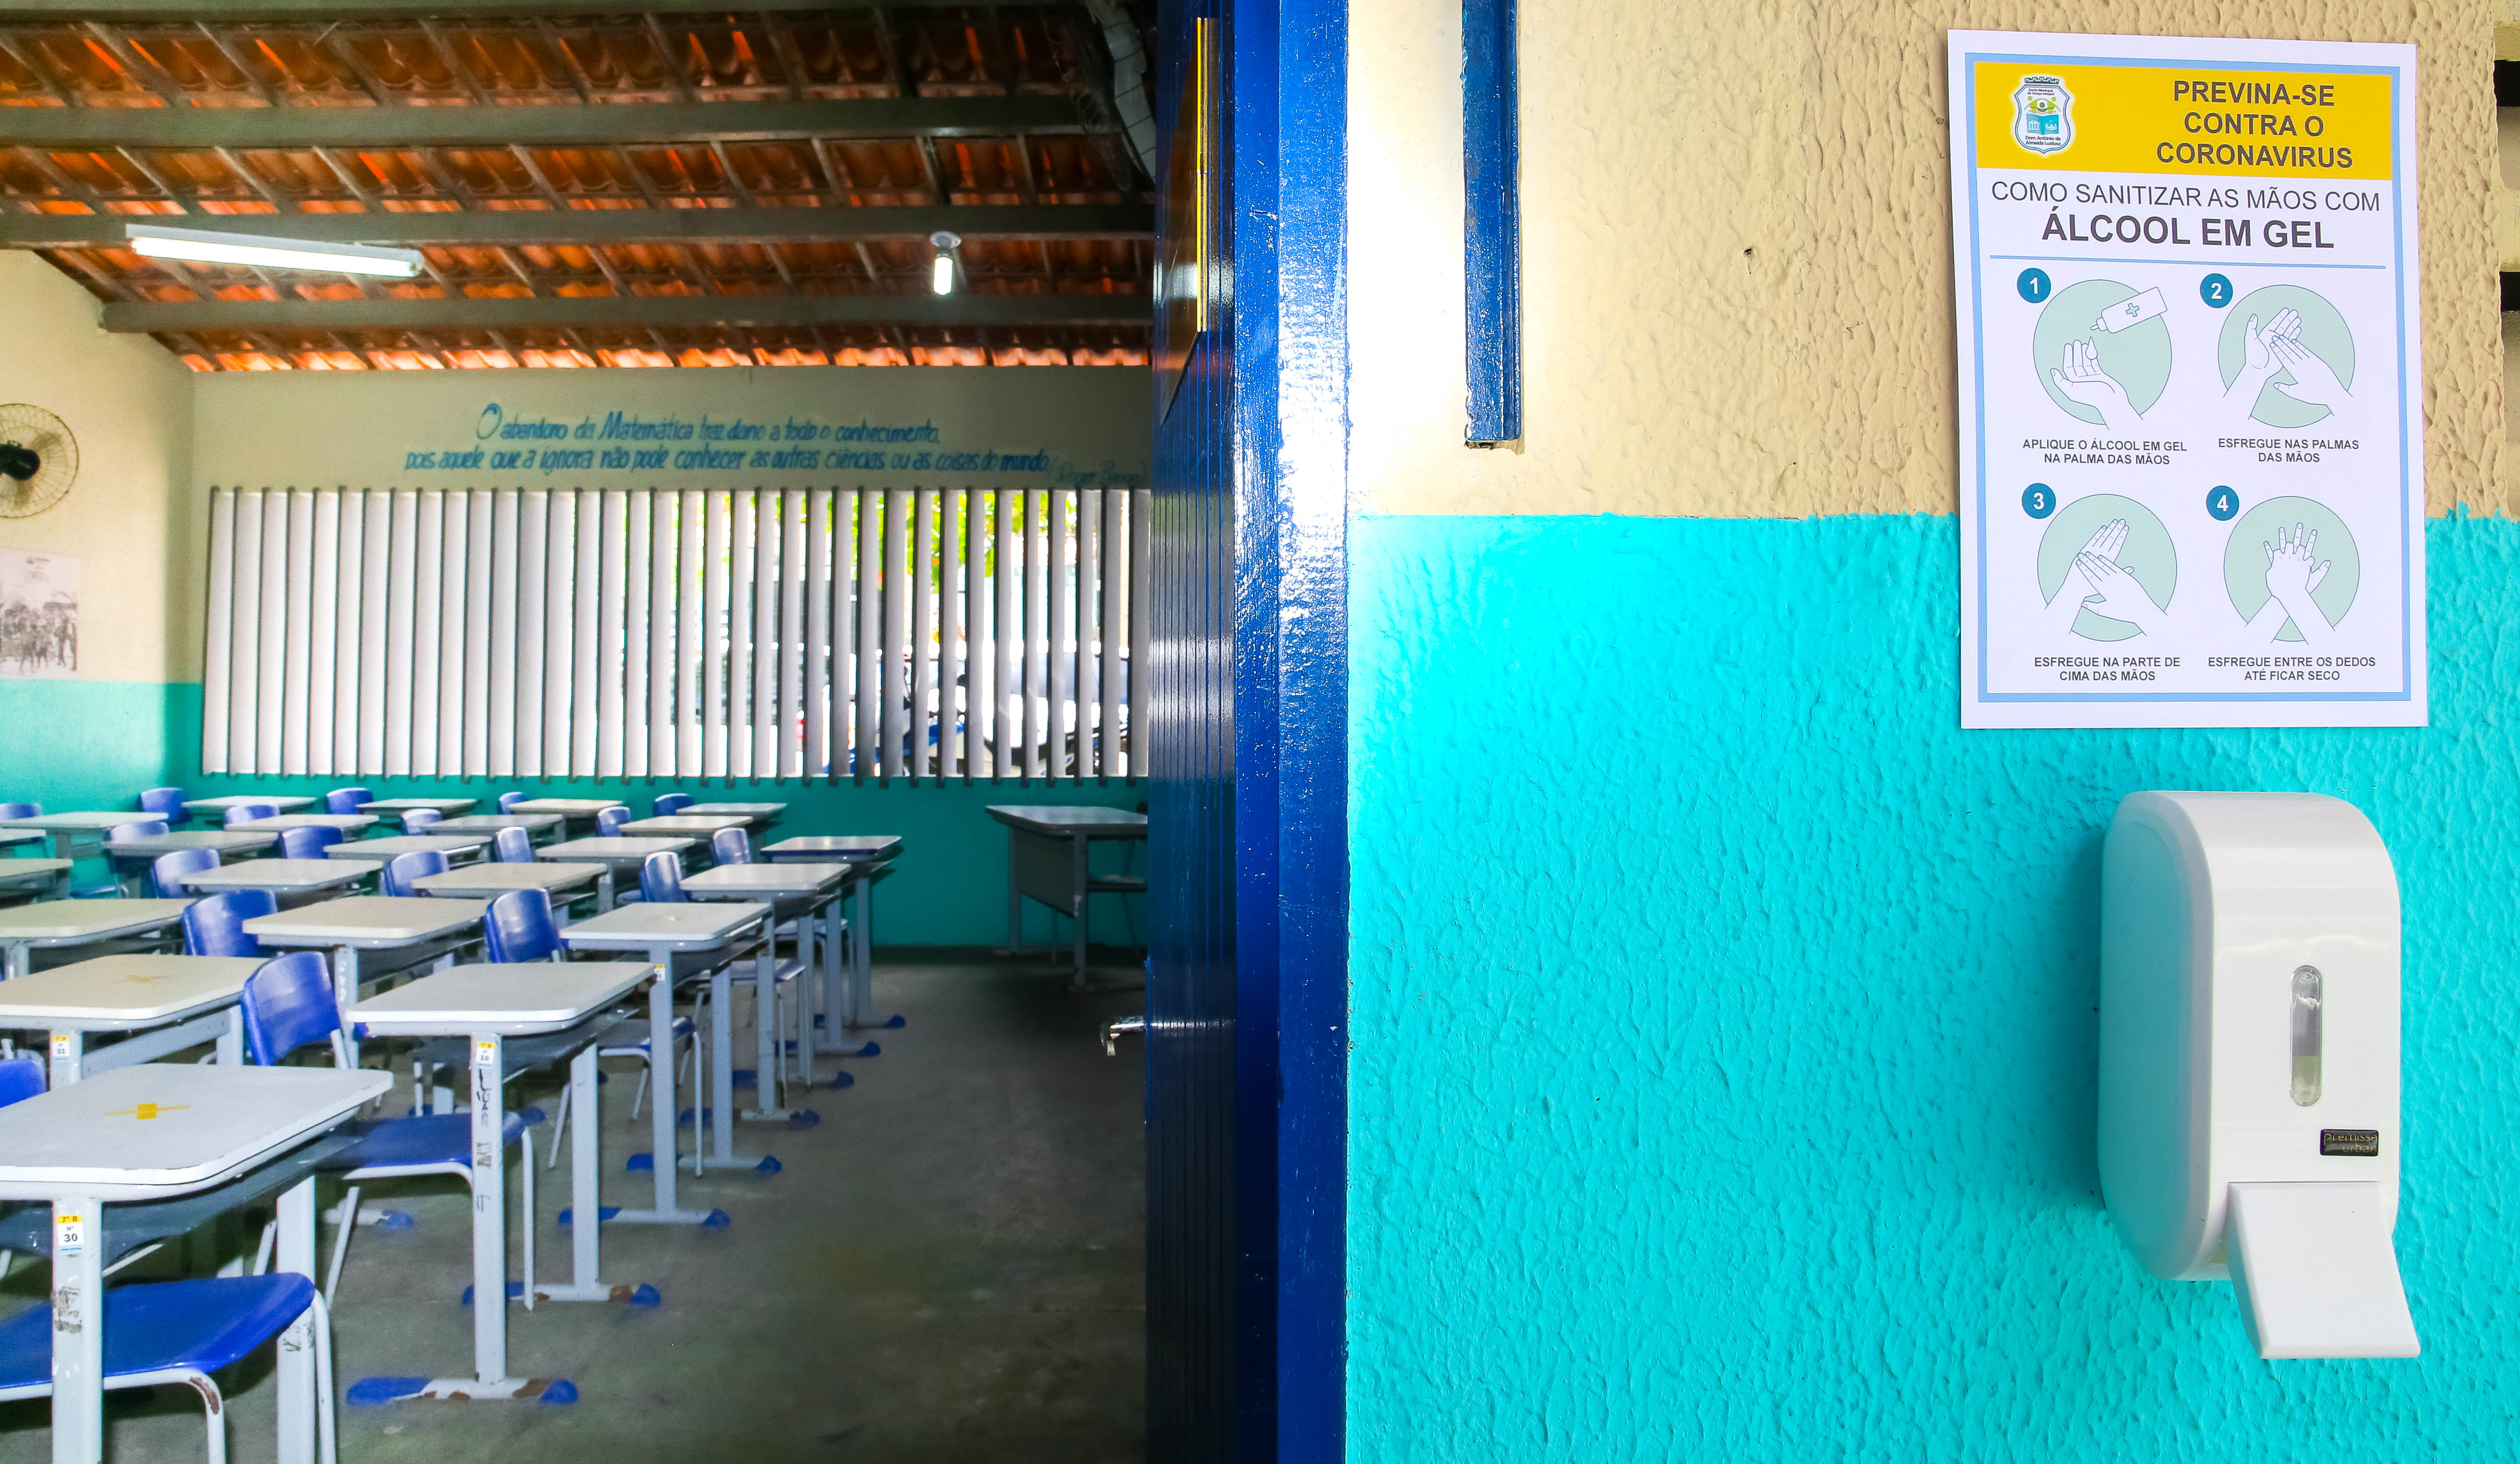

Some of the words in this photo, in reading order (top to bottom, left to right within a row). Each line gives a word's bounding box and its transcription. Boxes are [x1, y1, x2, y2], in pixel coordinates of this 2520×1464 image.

[2174, 80, 2335, 106] PREVINA-SE
[2184, 112, 2297, 136] CONTRA
[2304, 115, 2324, 137] O
[2157, 142, 2352, 168] CORONAVIRUS
[1992, 181, 2067, 202] COMO
[2076, 183, 2202, 206] SANITIZAR
[2207, 188, 2239, 208] AS
[2247, 186, 2317, 210] MÃOS
[2325, 191, 2379, 211] COM
[2042, 206, 2190, 244] ÁLCOOL
[2202, 218, 2251, 246] EM
[2263, 220, 2334, 248] GEL
[2030, 277, 2038, 294] 1
[2211, 283, 2222, 299] 2
[476, 403, 502, 440] O
[574, 415, 596, 440] da
[769, 425, 780, 441] a
[784, 416, 817, 441] todo
[819, 425, 831, 440] o
[2023, 439, 2074, 449] APLIQUE
[2078, 440, 2087, 449] O
[2091, 437, 2140, 450] ÁLCOOL
[2143, 441, 2160, 451] EM
[2164, 441, 2188, 451] GEL
[2219, 438, 2281, 448] ESFREGUE
[2285, 439, 2308, 449] NAS
[2312, 439, 2359, 449] PALMAS
[522, 450, 537, 469] a
[539, 450, 594, 476] ignora
[600, 446, 630, 469] não
[674, 442, 746, 470] conhecer
[749, 451, 770, 469] as
[771, 444, 822, 470] outras
[891, 453, 911, 470] ou
[912, 452, 933, 470] as
[935, 451, 981, 471] coisas
[982, 449, 999, 471] do
[2044, 453, 2061, 463] NA
[2064, 454, 2104, 464] PALMA
[2108, 454, 2132, 464] DAS
[2136, 453, 2170, 465] MÃOS
[2258, 452, 2282, 462] DAS
[2286, 451, 2320, 462] MÃOS
[2033, 492, 2044, 510] 3
[2217, 494, 2229, 512] 4
[2035, 657, 2099, 667] ESFREGUE
[2103, 657, 2119, 667] NA
[2123, 657, 2161, 667] PARTE
[2165, 657, 2180, 667] DE
[2208, 657, 2271, 667] ESFREGUE
[2275, 657, 2313, 666] ENTRE
[2316, 657, 2332, 666] OS
[2336, 657, 2375, 666] DEDOS
[2060, 671, 2089, 681] CIMA
[2093, 671, 2117, 681] DAS
[2121, 669, 2155, 681] MÃOS
[2245, 668, 2266, 680] ATÉ
[2270, 671, 2304, 680] FICAR
[2308, 671, 2340, 680] SECO
[2324, 1133, 2377, 1145] premisse
[2343, 1143, 2377, 1153] urban
[64, 1233, 78, 1242] 30
